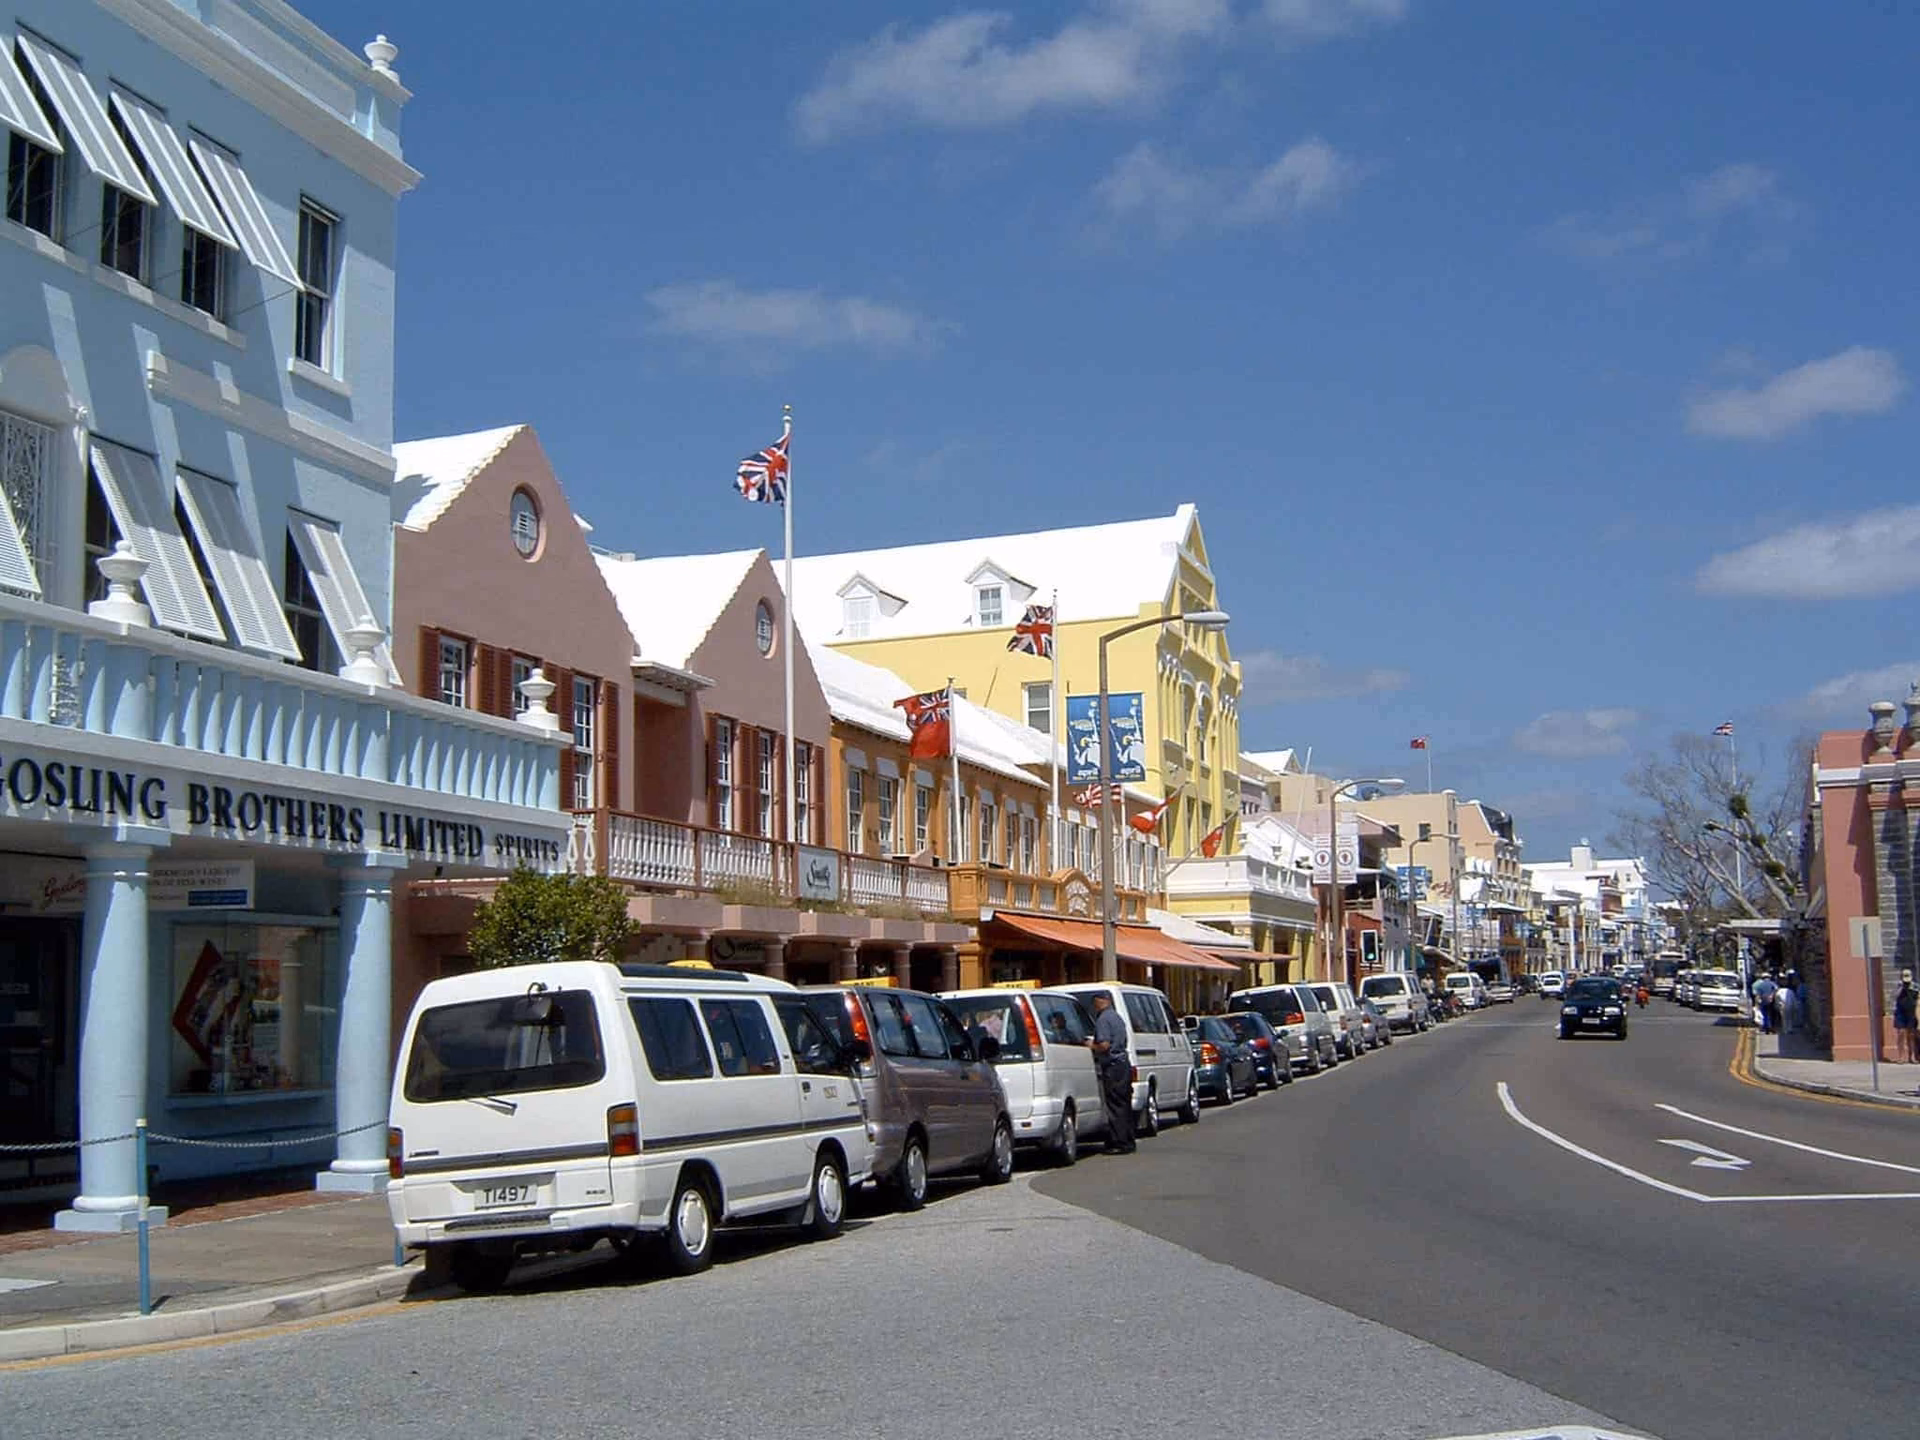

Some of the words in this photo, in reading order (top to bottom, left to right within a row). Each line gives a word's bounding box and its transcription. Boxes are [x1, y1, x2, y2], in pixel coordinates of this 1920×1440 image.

[188, 783, 364, 844] BROTHERS
[379, 811, 484, 857] LIMITED
[495, 833, 559, 861] SPIRITS
